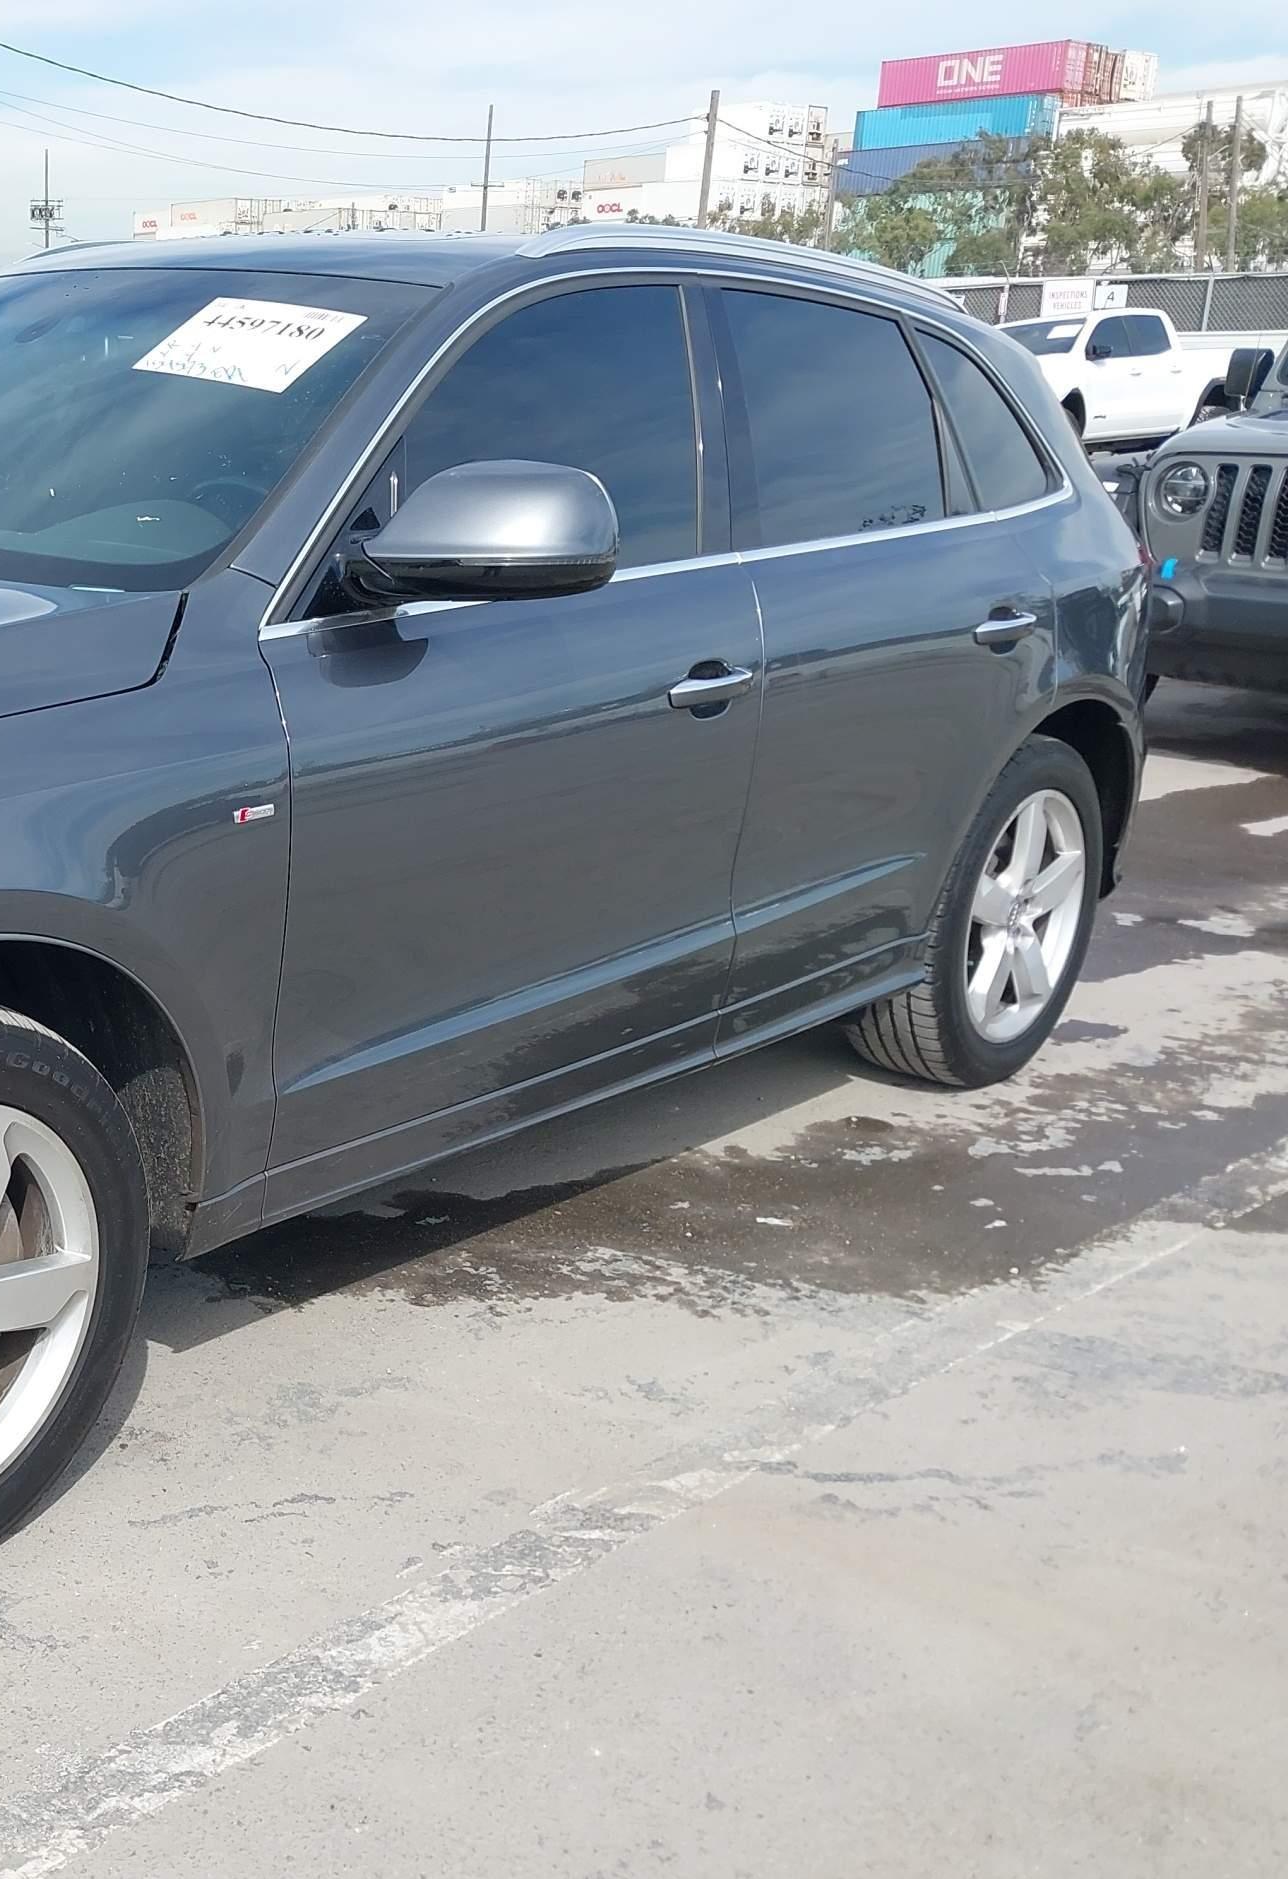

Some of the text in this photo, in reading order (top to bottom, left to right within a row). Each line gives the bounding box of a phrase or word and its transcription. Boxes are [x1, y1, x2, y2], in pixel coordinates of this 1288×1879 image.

[937, 54, 1004, 87] ONE
[597, 202, 623, 213] OOCL
[203, 314, 326, 341] 44597180
